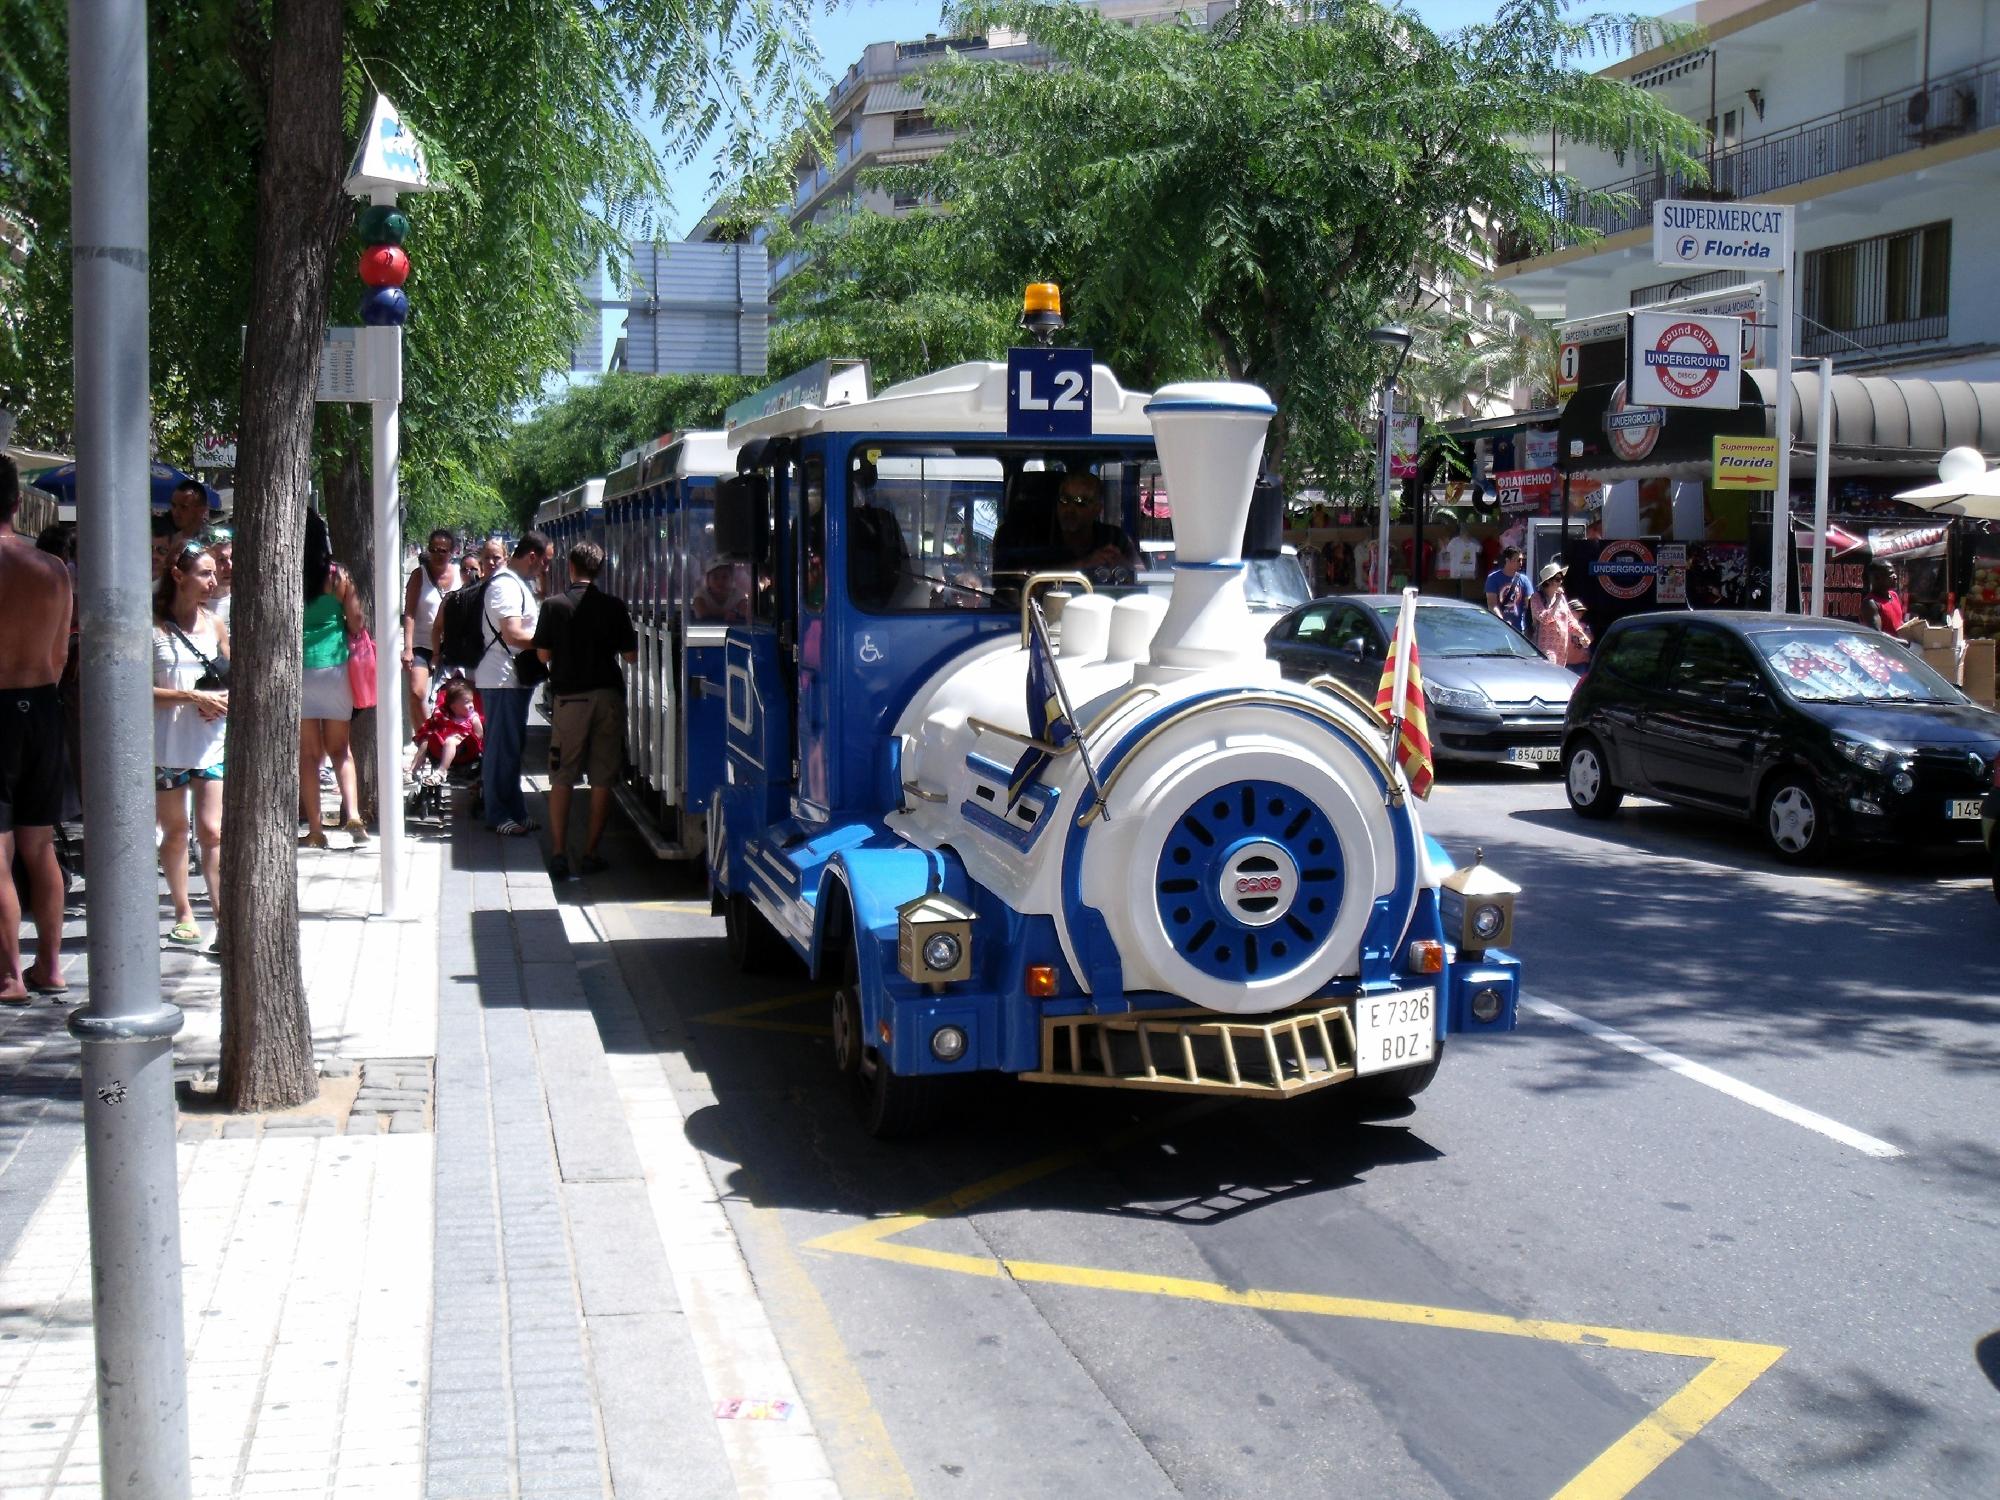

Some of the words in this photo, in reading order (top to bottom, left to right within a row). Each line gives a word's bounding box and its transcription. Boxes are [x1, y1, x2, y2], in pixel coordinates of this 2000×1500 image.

[1663, 206, 1782, 233] SUPERMERCAT
[1681, 240, 1695, 256] F
[1704, 240, 1771, 258] Florida
[1661, 325, 1691, 347] sound
[1693, 329, 1713, 349] club
[1647, 353, 1727, 368] UNDERGROUND
[1677, 371, 1697, 380] DISCO
[1019, 370, 1084, 411] L2
[1662, 375, 1683, 395] salou
[1690, 377, 1712, 395] spain
[1611, 411, 1661, 427] UNDERGROUND
[1720, 443, 1775, 452] Supermercat
[1720, 456, 1774, 468] Florida
[1497, 473, 1552, 488] ФЛАМЕНКО
[1501, 489, 1520, 504] 27
[1593, 565, 1658, 574] UNDERGROUND
[1517, 750, 1543, 760] 8540
[1546, 750, 1560, 760] DZ
[1957, 802, 1980, 816] 145
[1371, 1004, 1380, 1028] E
[1388, 996, 1430, 1025] 7326
[1382, 1033, 1419, 1062] BDZ
